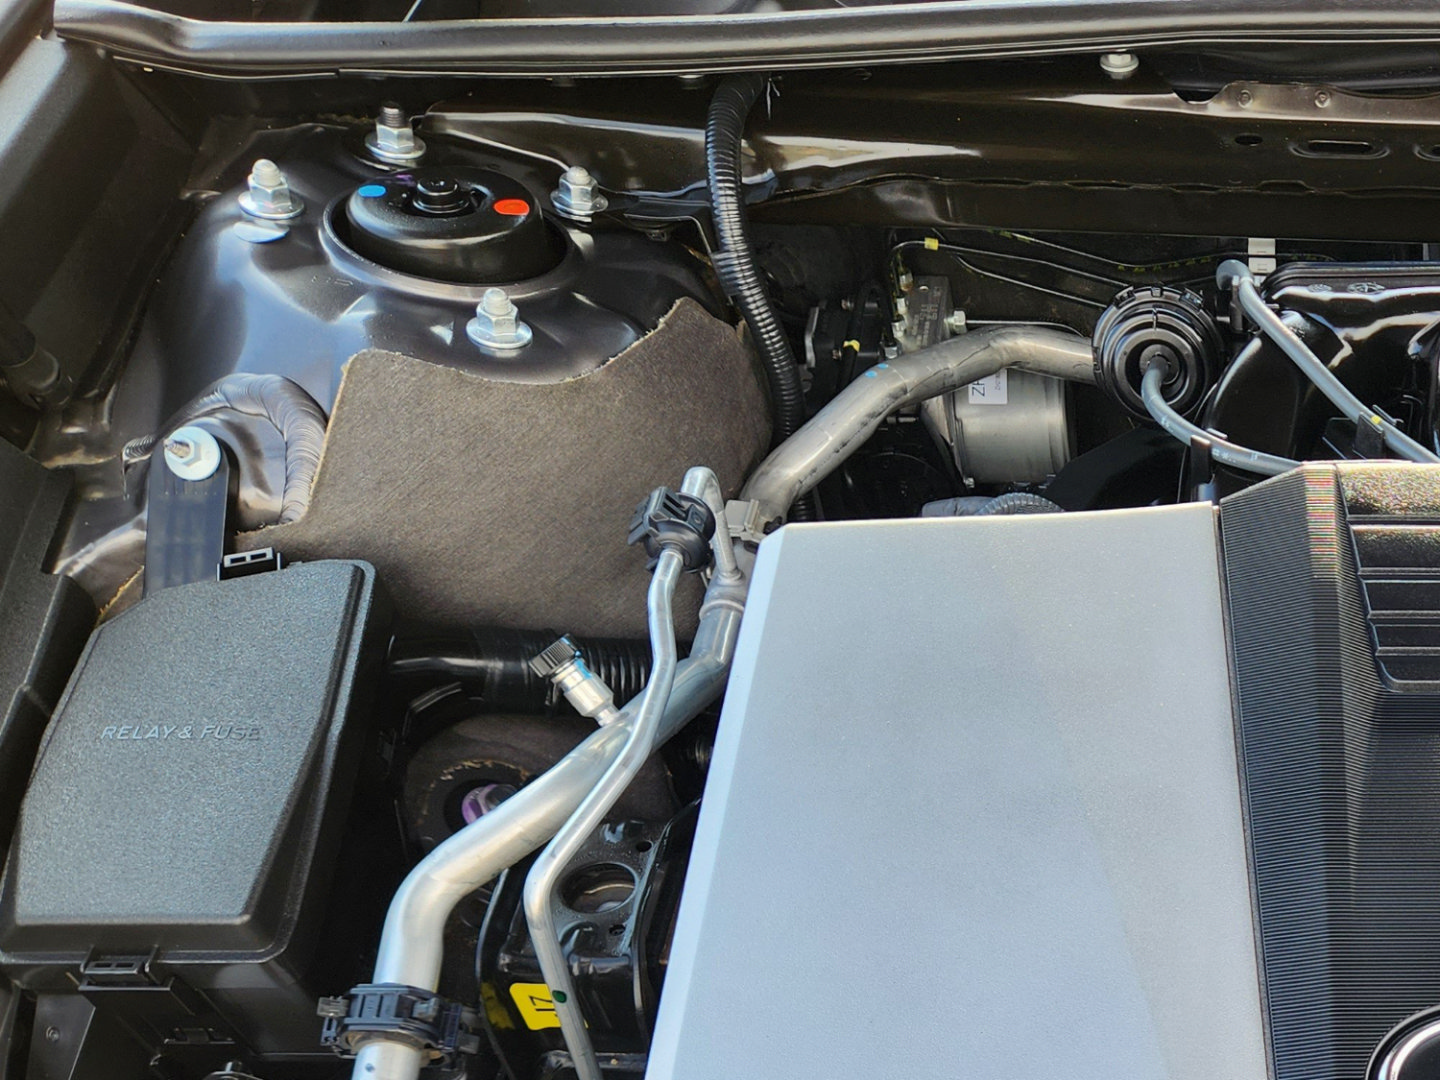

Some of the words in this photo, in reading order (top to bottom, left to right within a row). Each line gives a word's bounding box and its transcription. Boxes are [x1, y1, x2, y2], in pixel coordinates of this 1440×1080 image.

[100, 724, 176, 741] RELAY
[178, 725, 194, 740] &
[200, 724, 262, 741] FUSE
